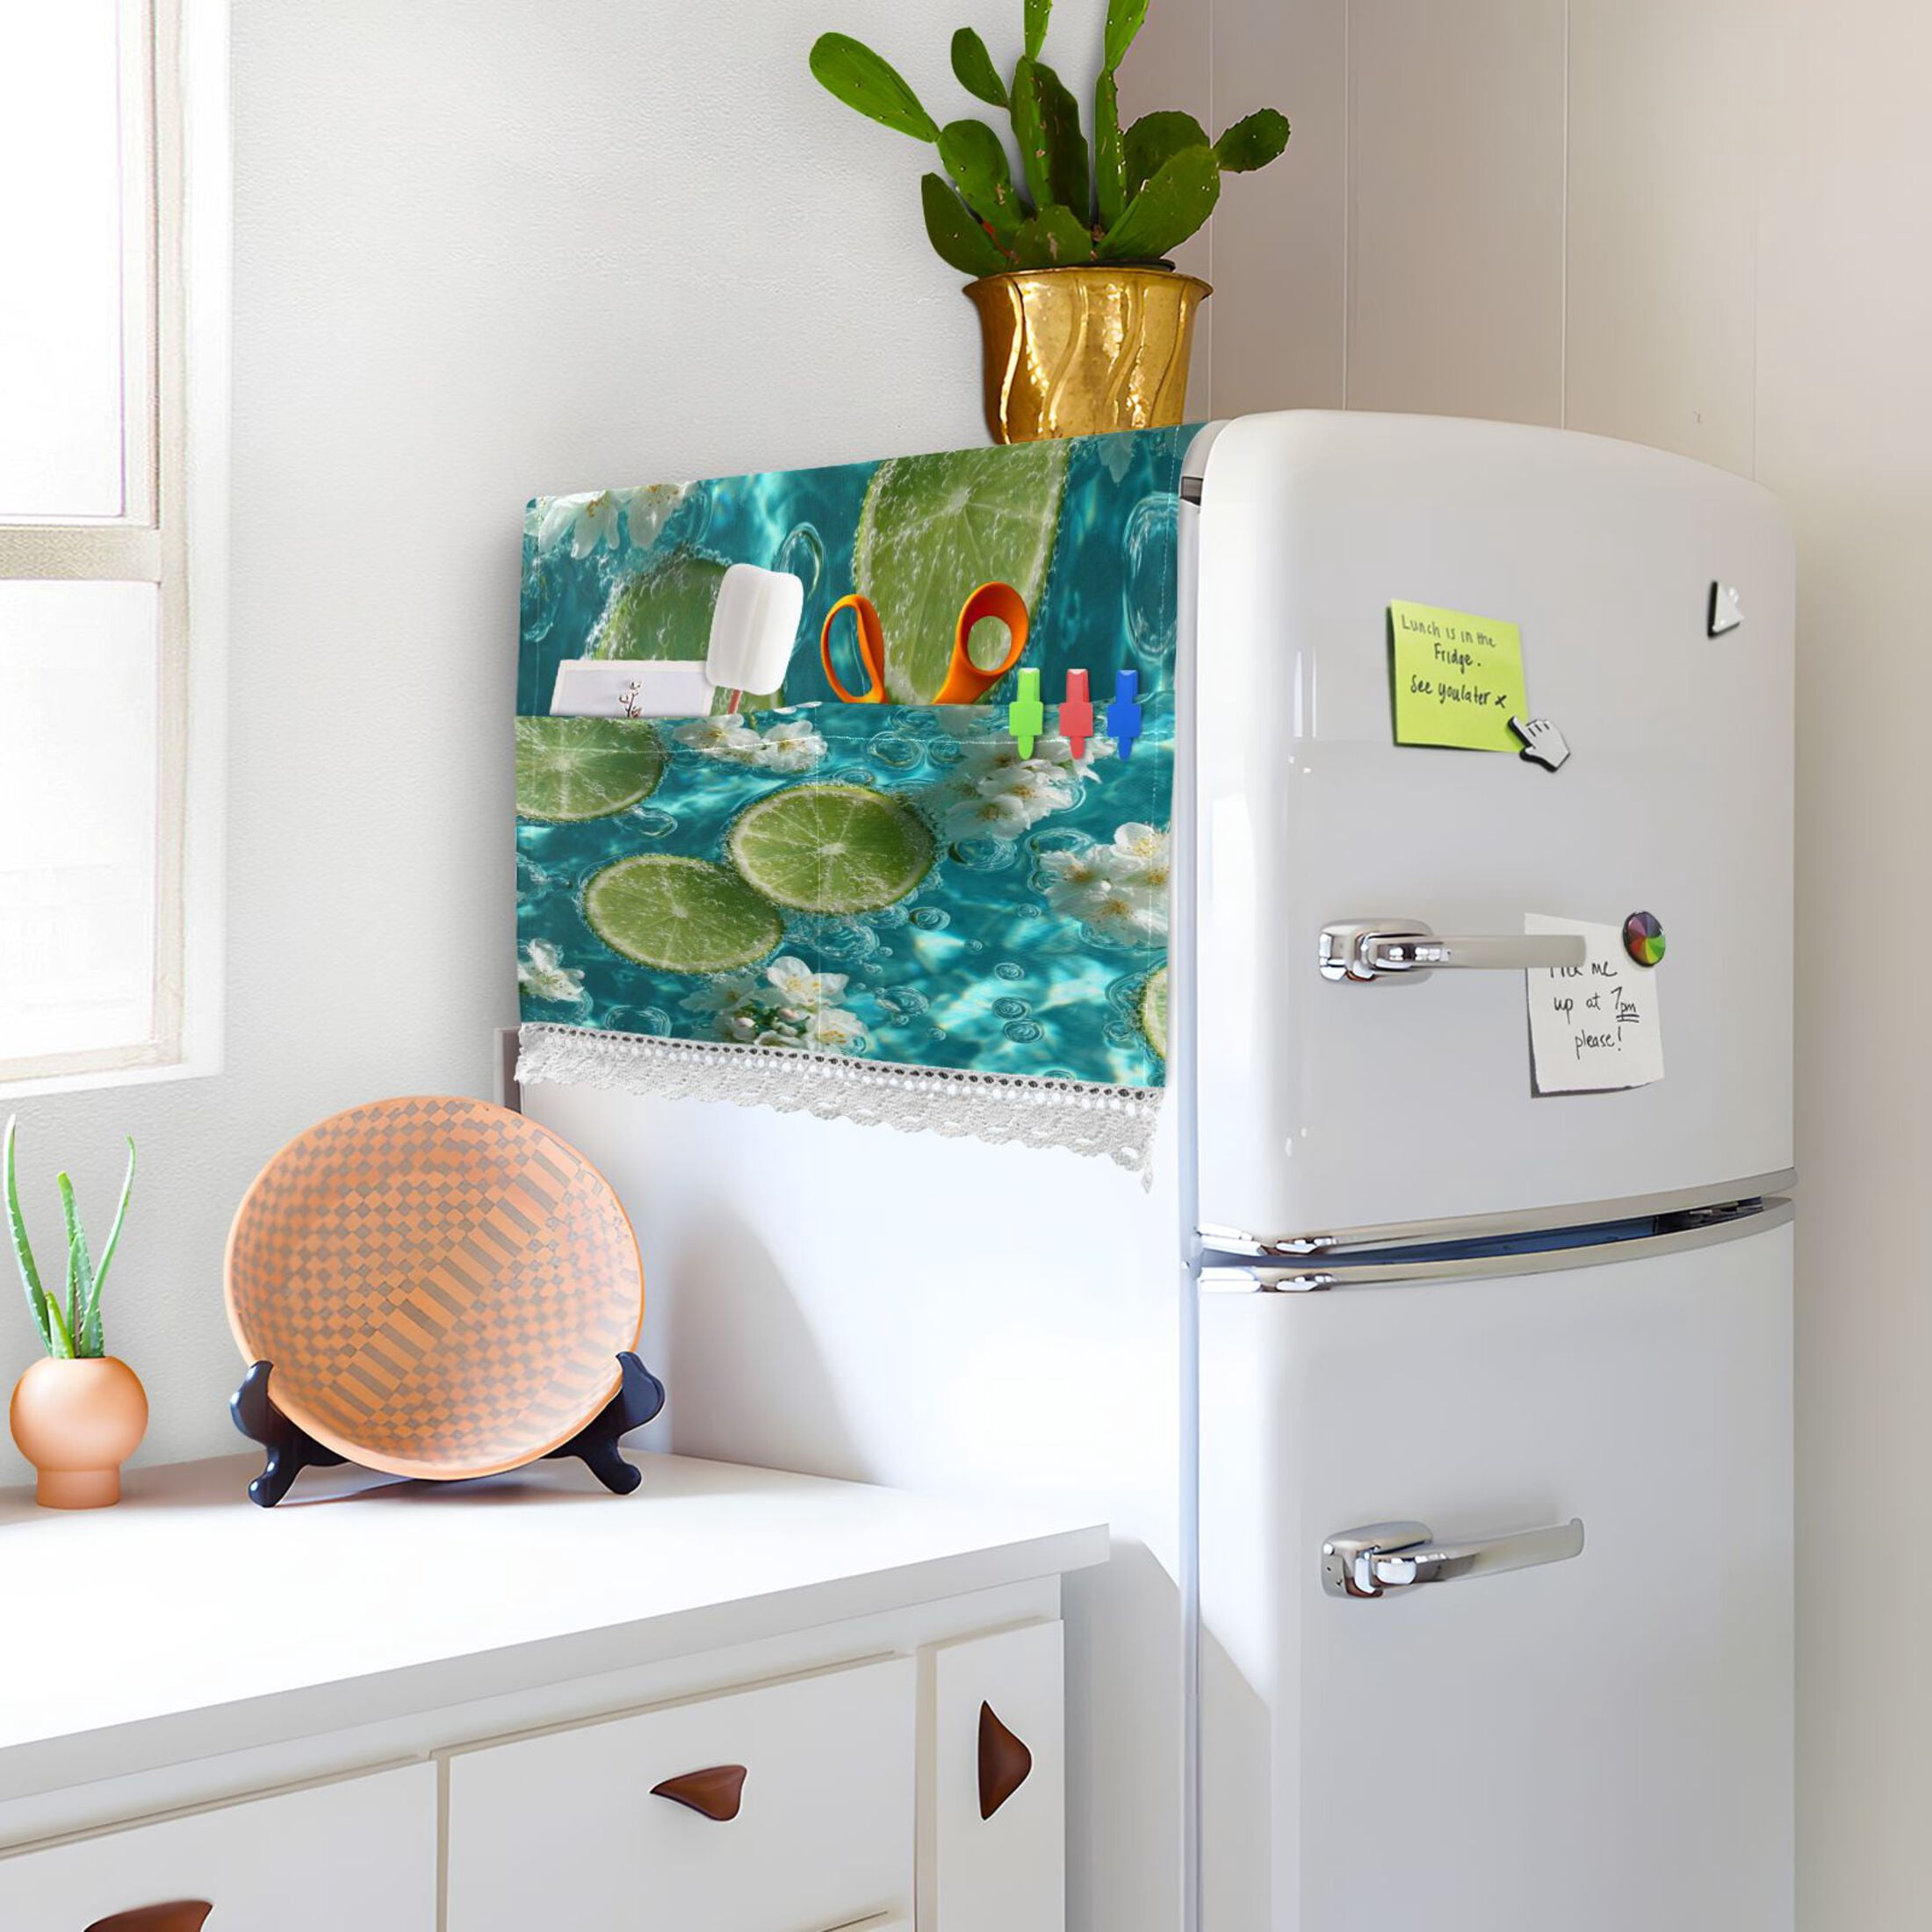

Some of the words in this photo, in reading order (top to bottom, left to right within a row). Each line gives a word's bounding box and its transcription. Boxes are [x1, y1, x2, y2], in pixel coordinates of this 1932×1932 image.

[1401, 614, 1441, 638] Lunch
[1460, 631, 1474, 644] in
[1477, 631, 1497, 648] the
[1410, 674, 1433, 693] See
[1591, 961, 1618, 977] me
[1554, 997, 1574, 1025] up
[1586, 992, 1601, 1011] at
[1575, 1026, 1621, 1060] please!
